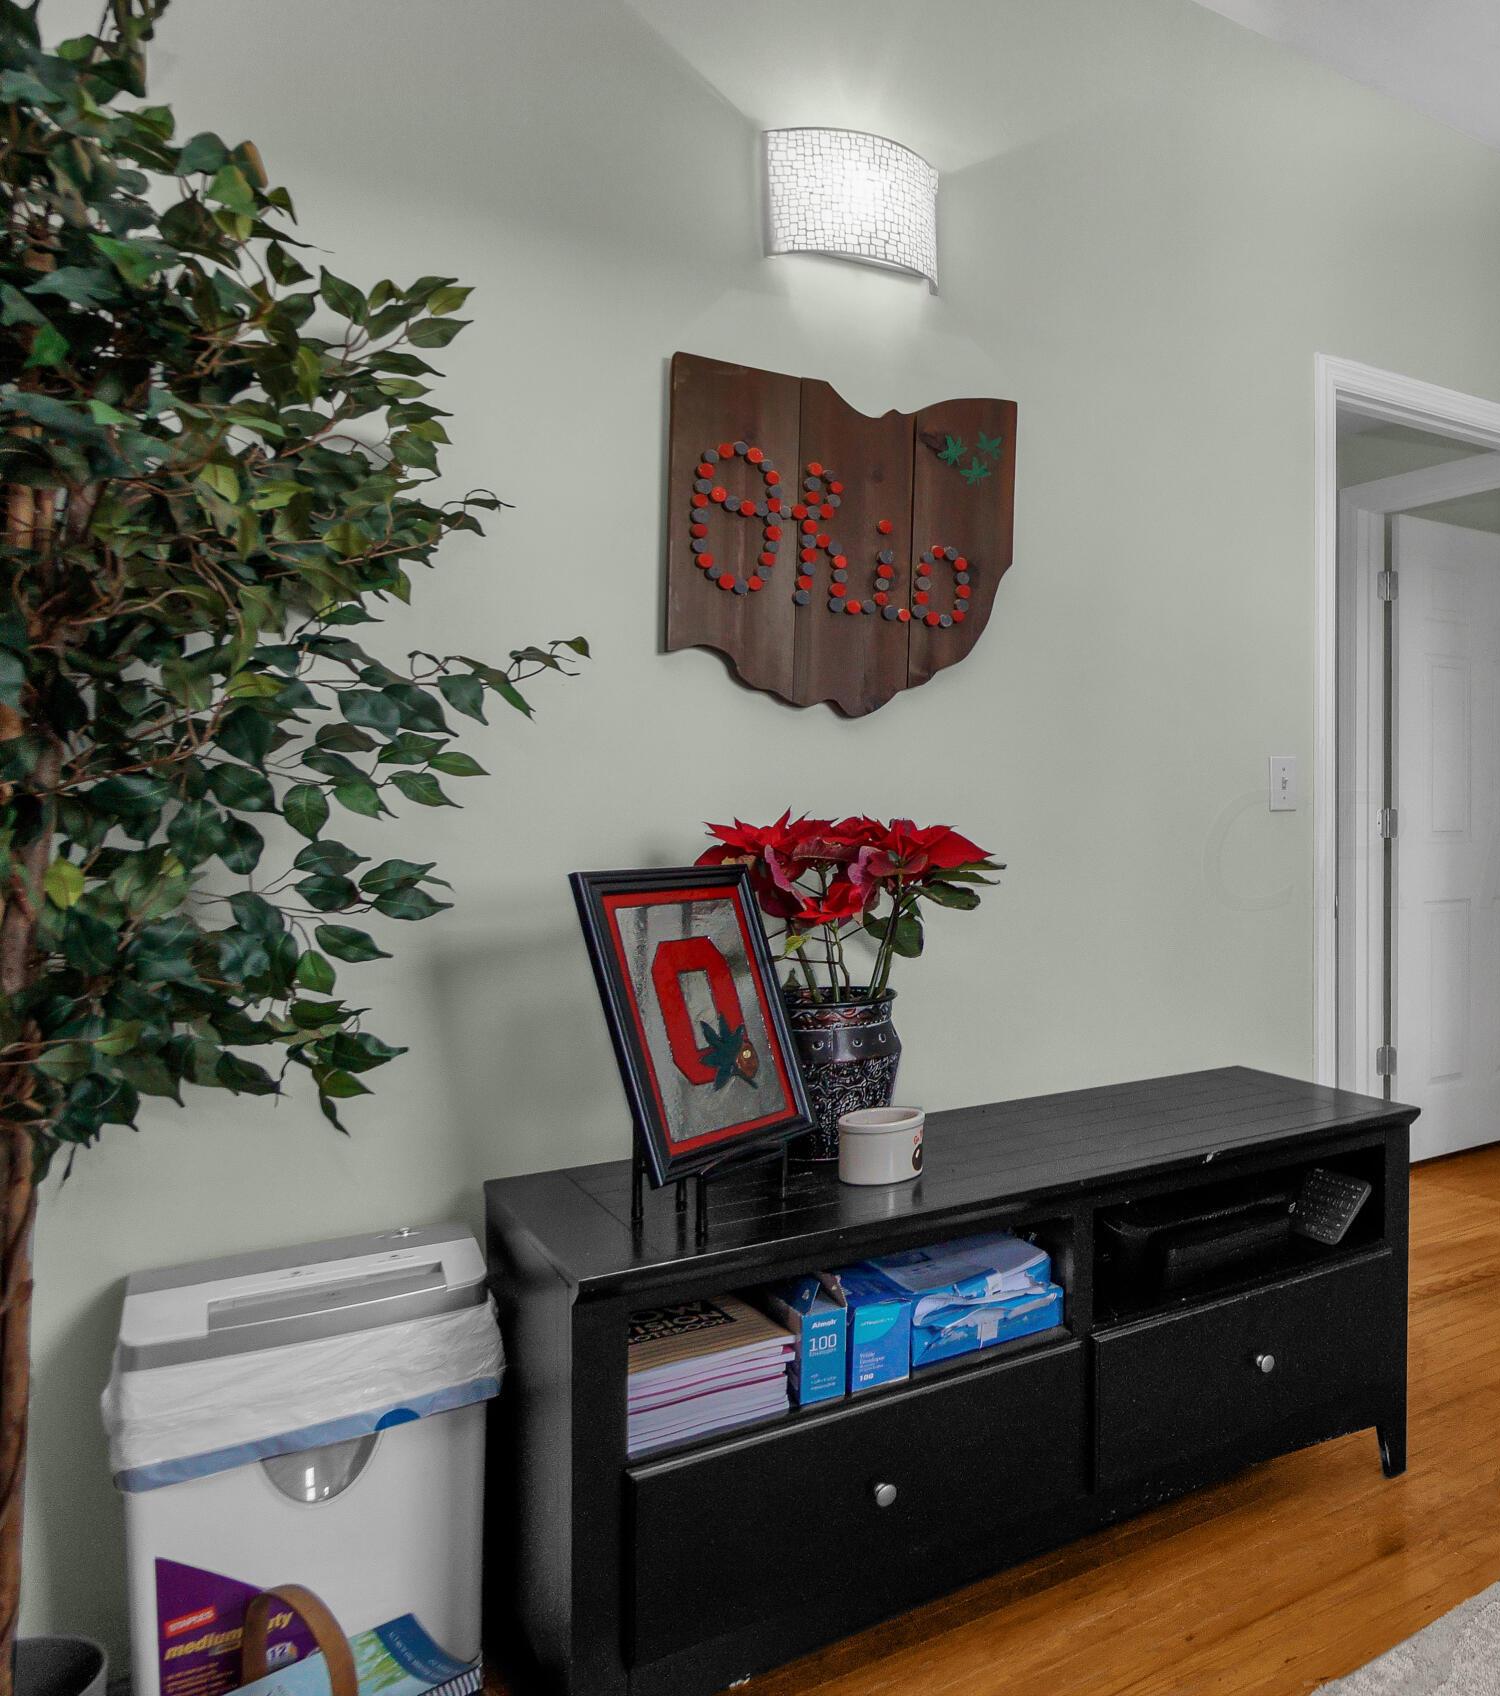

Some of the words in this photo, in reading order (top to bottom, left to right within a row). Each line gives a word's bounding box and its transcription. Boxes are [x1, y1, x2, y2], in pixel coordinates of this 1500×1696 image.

[690, 441, 970, 628] Ohio
[629, 1310, 722, 1334] ISION
[630, 1301, 704, 1323] OW
[809, 1333, 837, 1352] 100
[859, 1373, 874, 1382] 100
